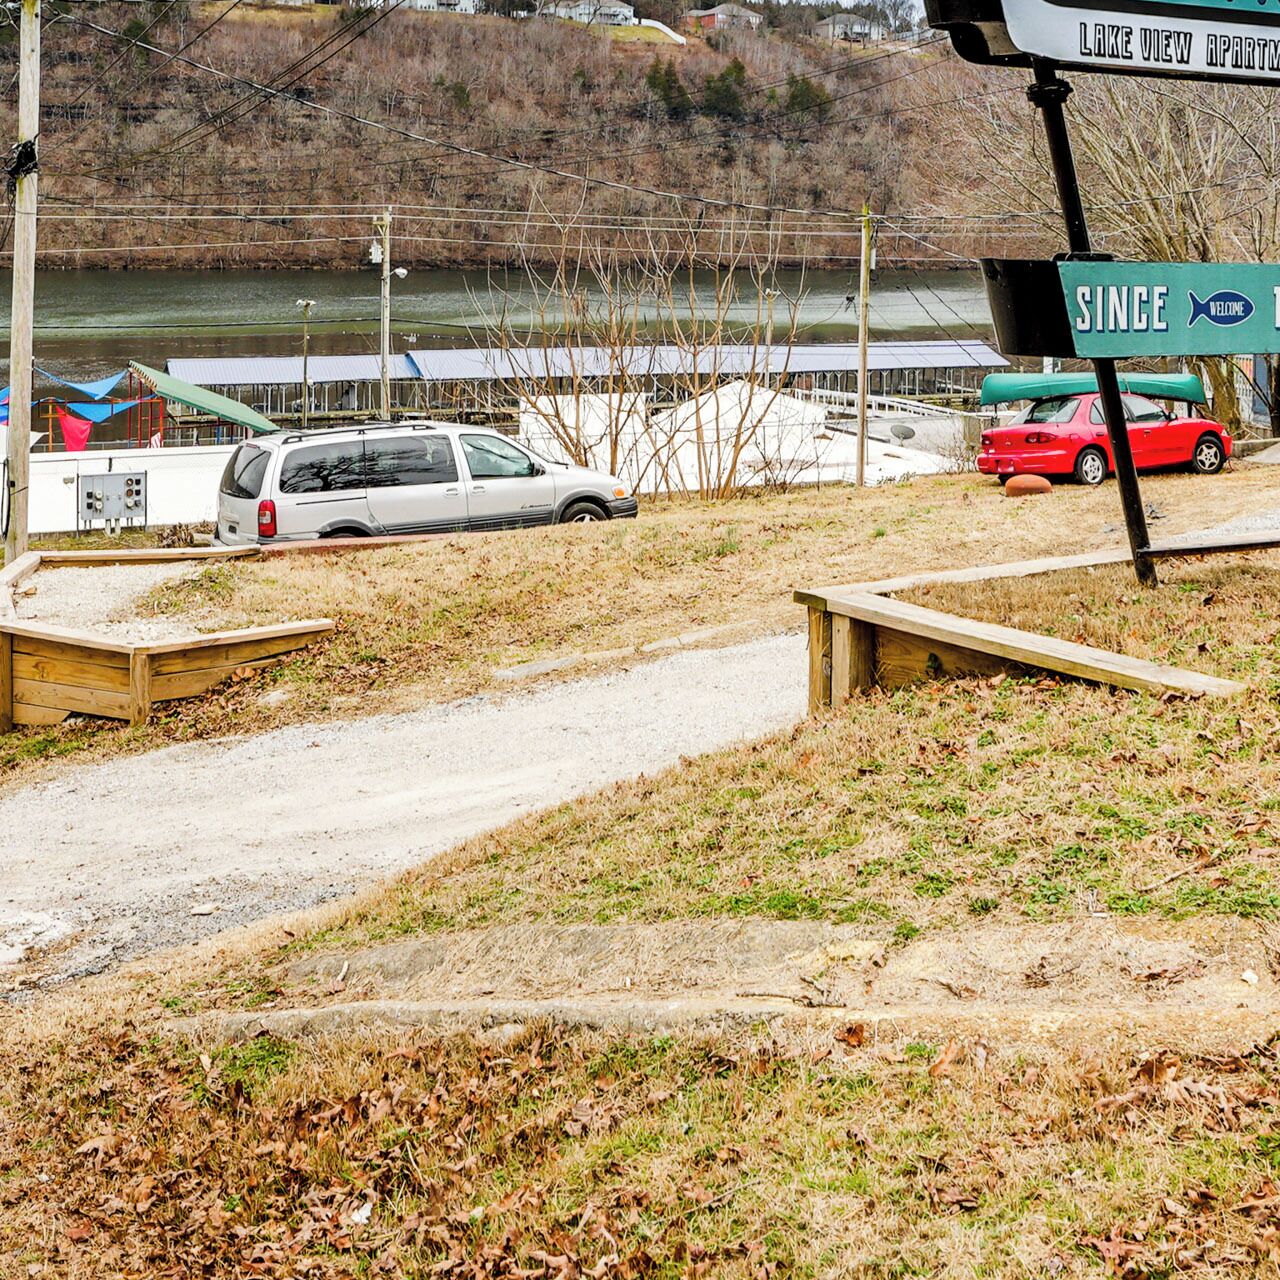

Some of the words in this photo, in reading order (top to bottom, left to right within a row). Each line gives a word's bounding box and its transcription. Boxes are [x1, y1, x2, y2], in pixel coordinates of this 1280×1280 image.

[1079, 23, 1133, 59] LAKE
[1140, 28, 1192, 64] VIEW
[1076, 285, 1168, 333] SINCE
[1210, 301, 1245, 316] WELCOME
